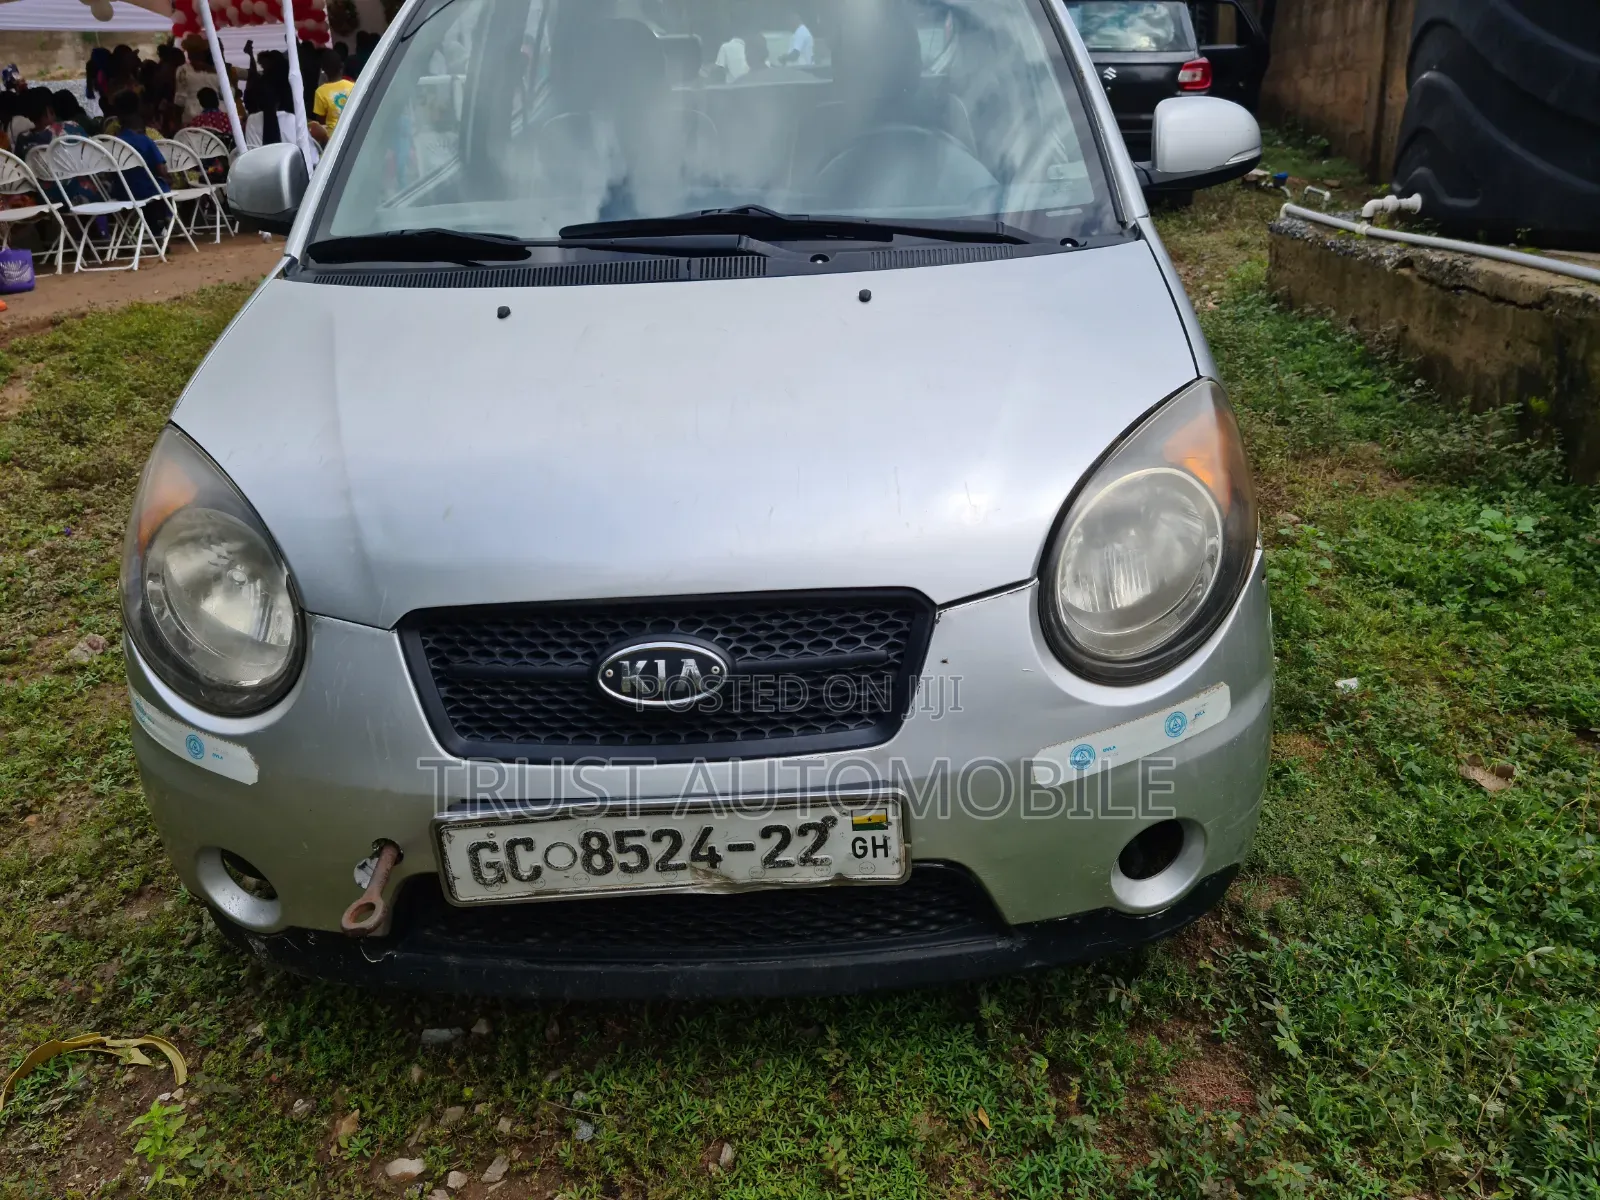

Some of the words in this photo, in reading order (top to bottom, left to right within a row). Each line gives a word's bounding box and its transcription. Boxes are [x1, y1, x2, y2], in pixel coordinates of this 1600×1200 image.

[618, 658, 703, 693] KIA
[467, 837, 542, 886] GC
[578, 817, 834, 877] 8524-22
[852, 835, 889, 859] GH
